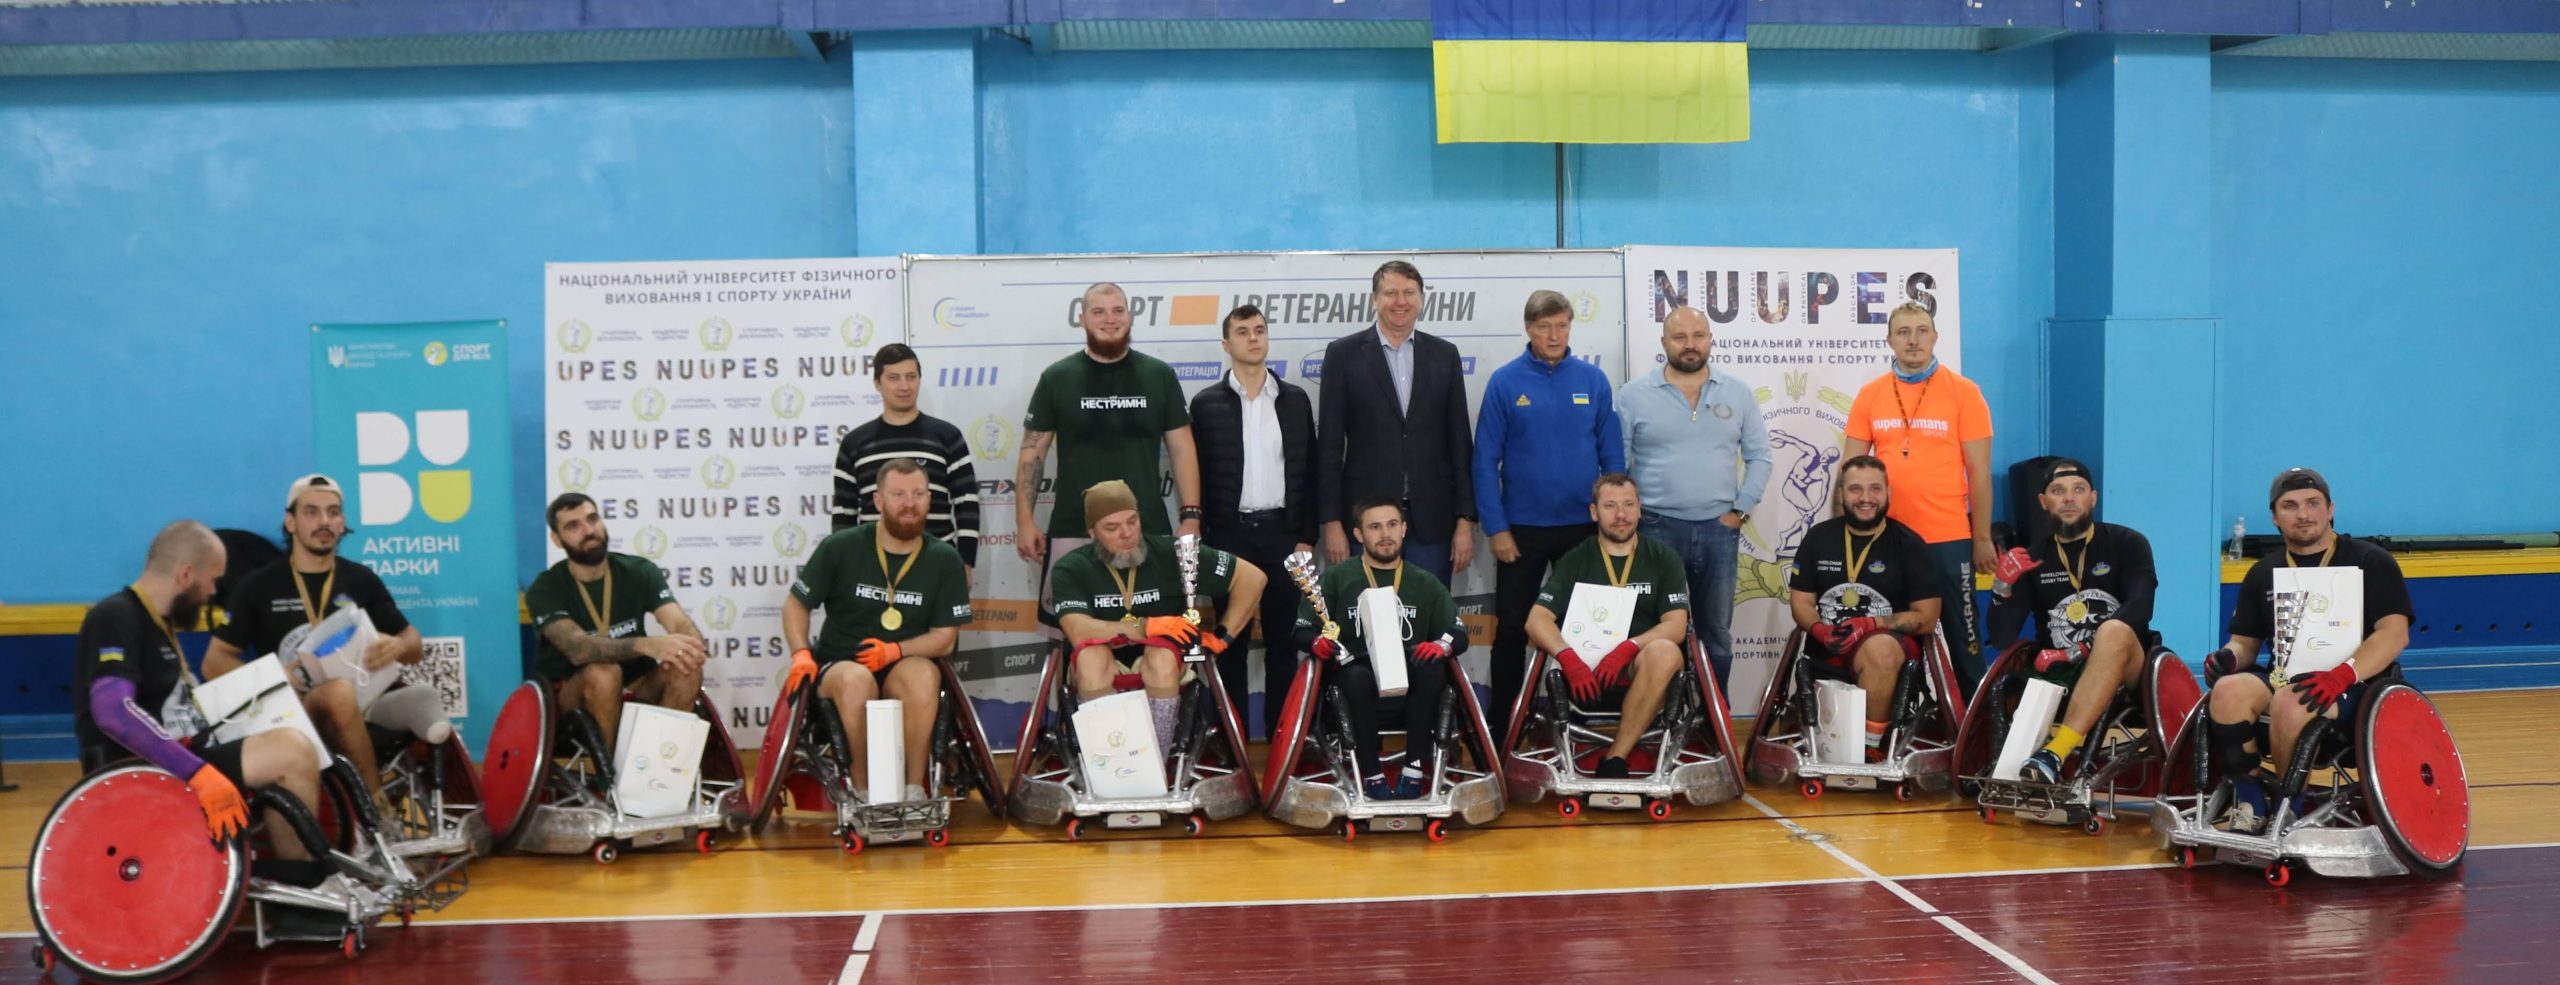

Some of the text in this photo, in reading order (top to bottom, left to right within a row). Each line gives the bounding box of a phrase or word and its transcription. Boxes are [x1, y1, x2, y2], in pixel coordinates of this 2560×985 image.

[559, 268, 896, 290] НАЦІОНАЛЬНИЙ УНІВЕРСИТЕТ ФІЗИЧНОГО
[605, 287, 852, 305] ВИХОВАННЯ І СПОРТУ УКРАЇНИ
[1654, 269, 1937, 325] NUUPES
[1068, 295, 1164, 328] СРТ
[1801, 312, 1807, 324] ON
[1710, 336, 1888, 351] АЦІОНАЛЬНИЙ УНІВЕРСИТЕТ
[1737, 354, 1814, 365] ВИХОВАННЯ
[1828, 354, 1877, 365] СПОРТУ
[557, 360, 638, 382] UPES
[657, 357, 780, 381] NUUPES
[1176, 365, 1219, 379] НТЕГРАЦІЯ
[1080, 398, 1147, 410] НЕСТРИМНІ
[1763, 406, 1811, 424] ІЗИЧНОГО
[589, 427, 711, 451] NUUPES
[659, 495, 781, 519] NUUPES
[363, 535, 461, 555] АКТИВНІ
[362, 558, 440, 577] ПАРКИ
[1094, 591, 1160, 608] НЕСТИМНІ
[1960, 562, 1976, 642] UKRAINE
[1459, 604, 1484, 615] ПОРТ
[1004, 653, 1037, 668] СПОРТ
[1735, 651, 1781, 660] ПОРТИВН
